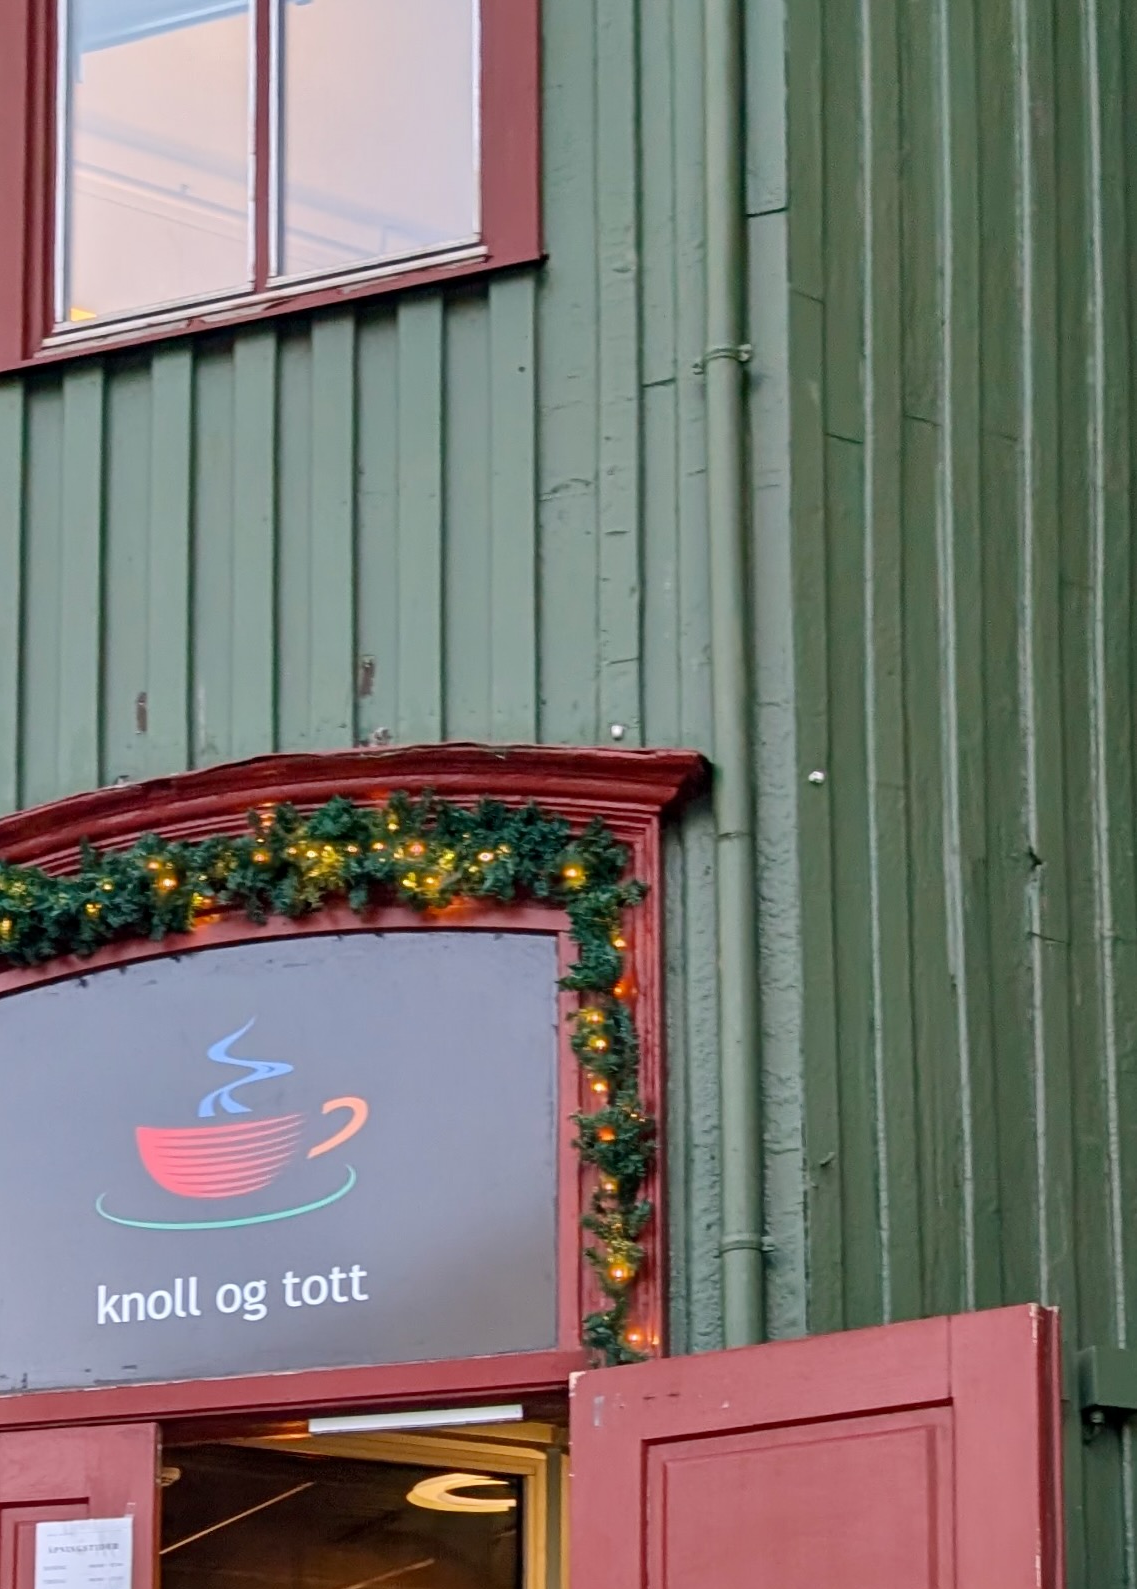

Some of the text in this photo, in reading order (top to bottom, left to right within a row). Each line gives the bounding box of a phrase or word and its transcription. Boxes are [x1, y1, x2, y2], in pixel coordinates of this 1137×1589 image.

[96, 1264, 369, 1325] knoll og tott
